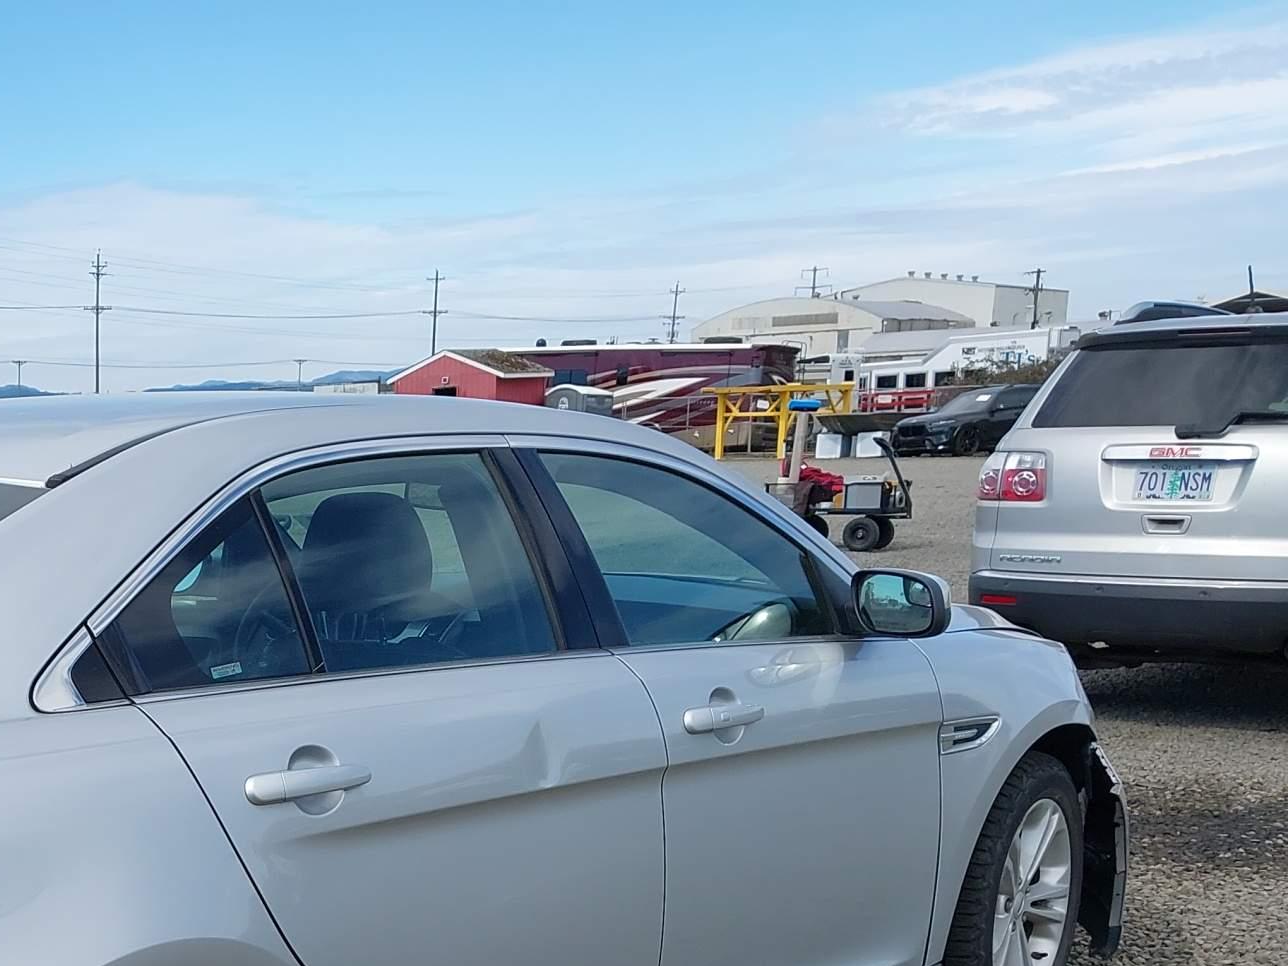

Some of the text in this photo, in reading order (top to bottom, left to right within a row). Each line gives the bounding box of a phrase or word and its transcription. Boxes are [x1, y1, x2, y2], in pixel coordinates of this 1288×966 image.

[1149, 447, 1202, 458] GMC
[1139, 471, 1213, 492] 701 NSM
